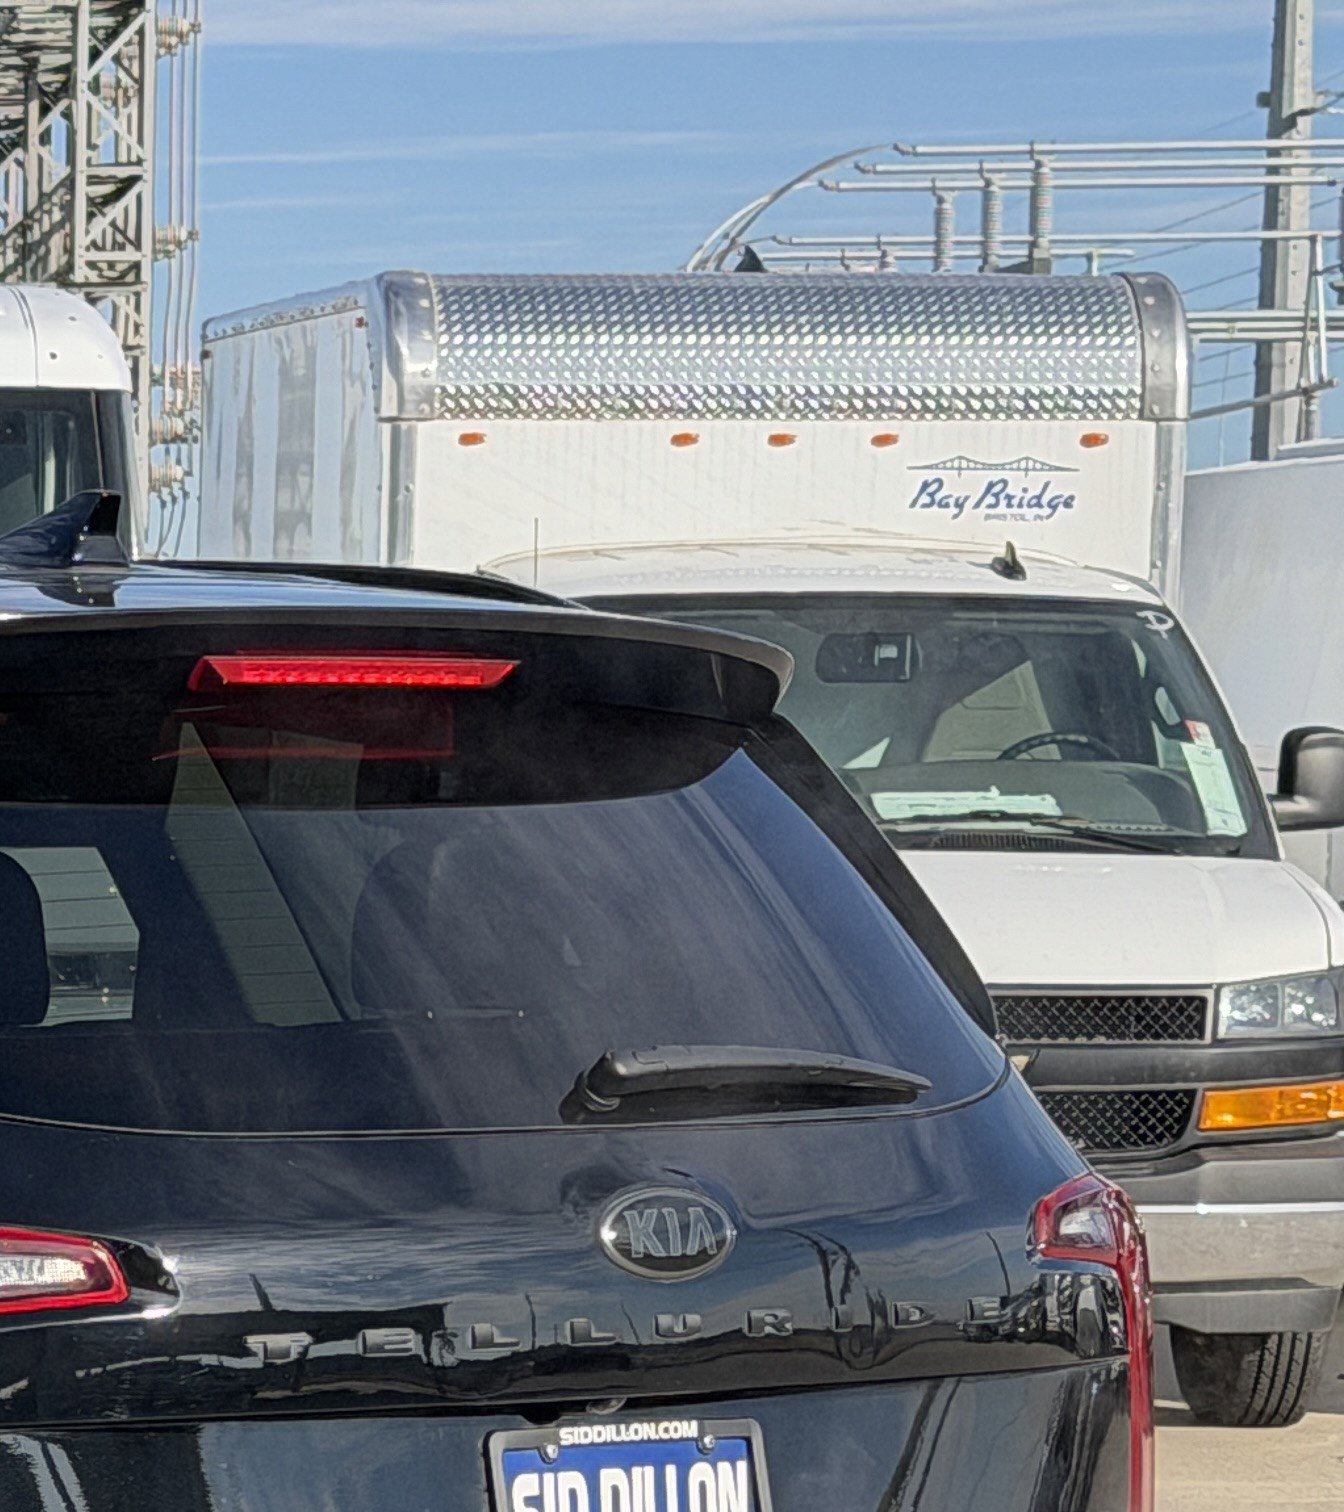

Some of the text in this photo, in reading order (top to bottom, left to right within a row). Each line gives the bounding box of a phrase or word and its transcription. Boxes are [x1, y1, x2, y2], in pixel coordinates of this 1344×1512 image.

[908, 477, 1076, 520] Bay Bridge
[623, 1206, 718, 1258] KIA
[242, 1296, 1006, 1365] TELLURIDE
[558, 1419, 699, 1446] SIDDILLON.COM
